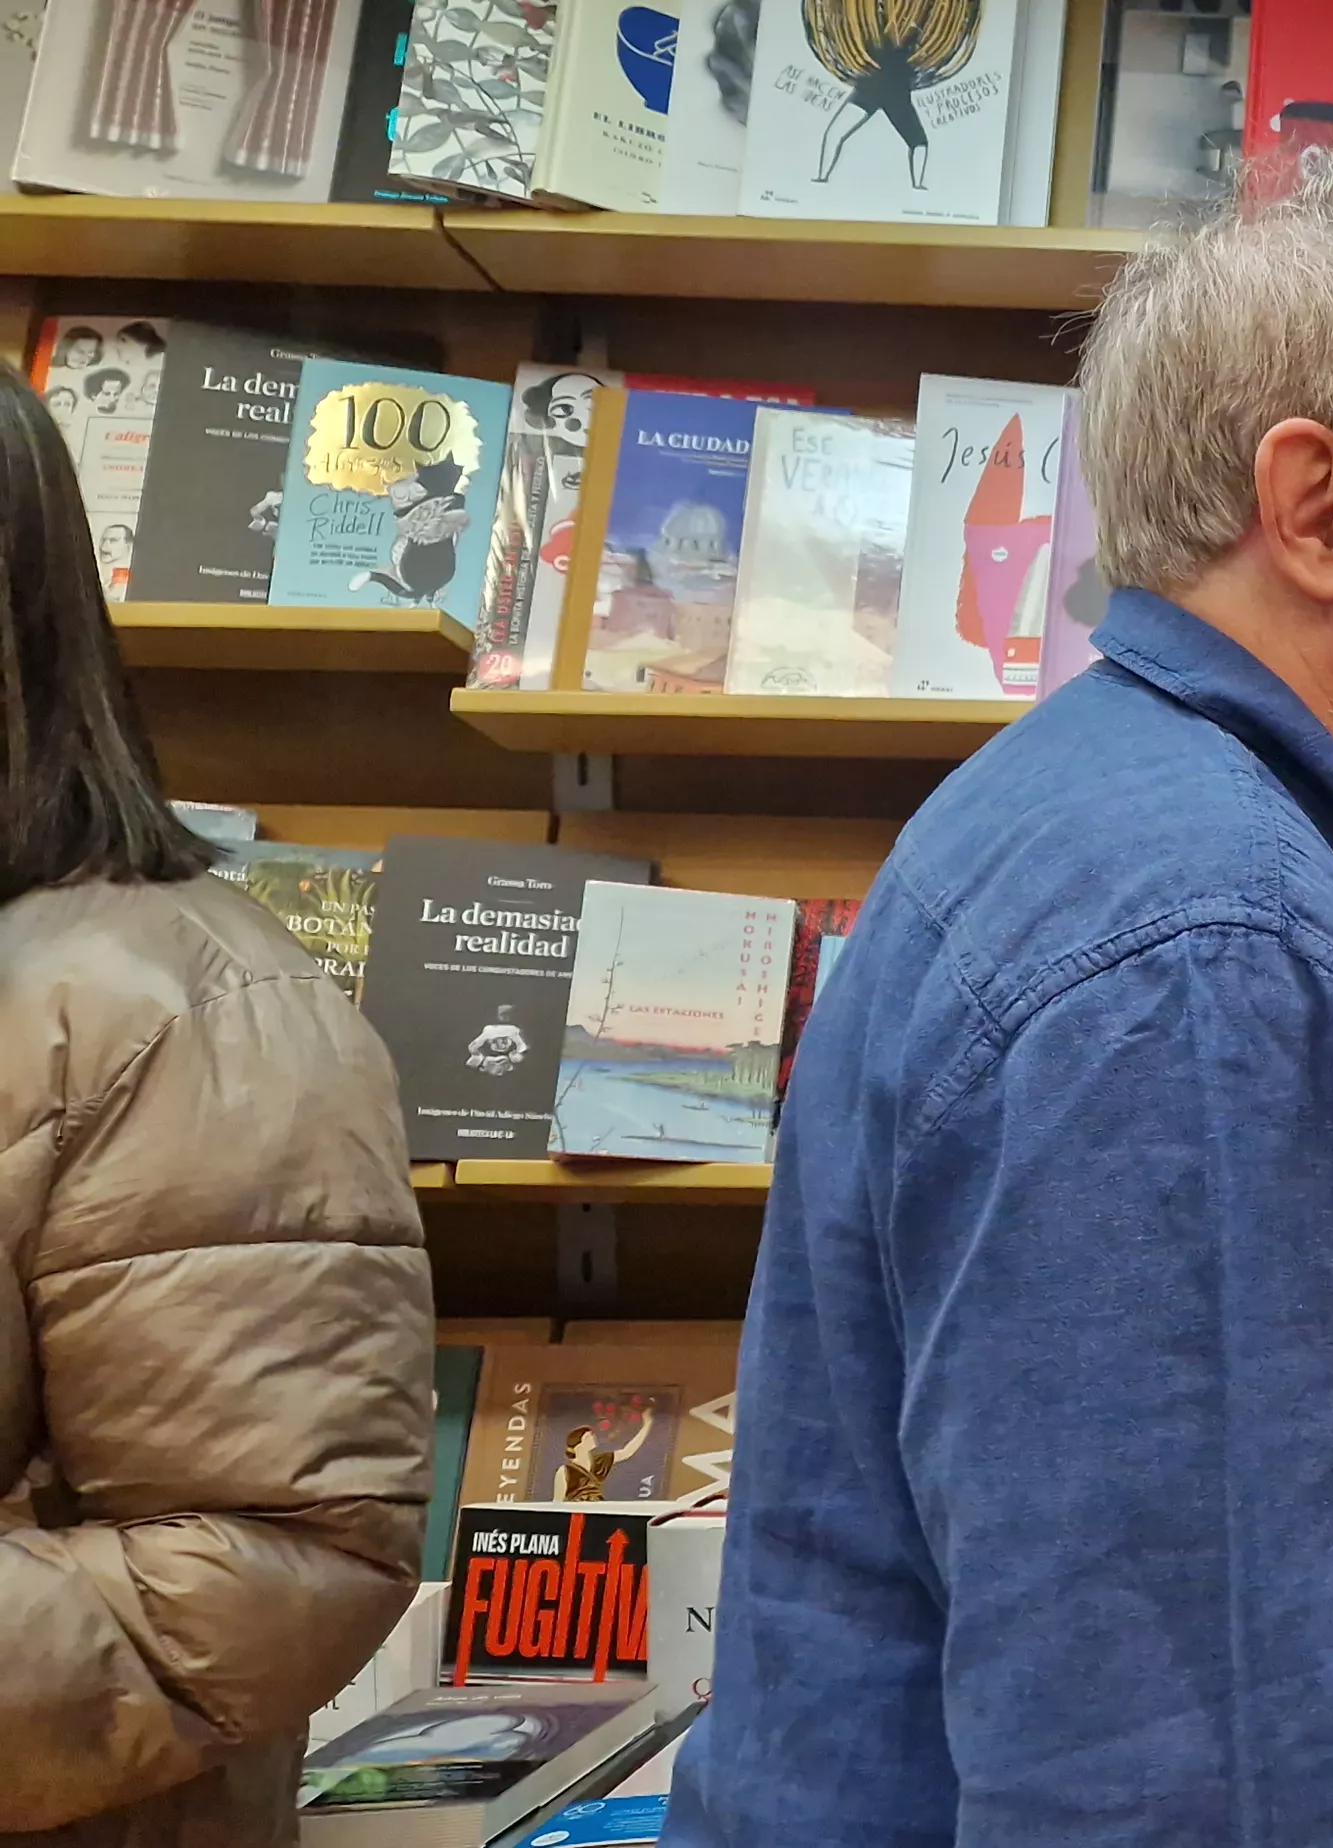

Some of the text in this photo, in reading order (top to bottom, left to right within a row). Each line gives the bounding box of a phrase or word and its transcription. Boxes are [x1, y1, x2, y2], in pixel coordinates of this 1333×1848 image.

[202, 366, 238, 393] La
[338, 394, 452, 452] 100
[636, 429, 751, 455] LA CIUDAD
[940, 426, 1026, 485] Jesús
[309, 490, 375, 517] Chris
[305, 510, 386, 543] Riddell
[419, 898, 457, 925] La
[454, 929, 570, 959] realidad
[629, 1003, 725, 1021] LAS ESTACIONES
[496, 1382, 532, 1504] EYENDAS
[471, 1530, 560, 1556] INÉS PLANA
